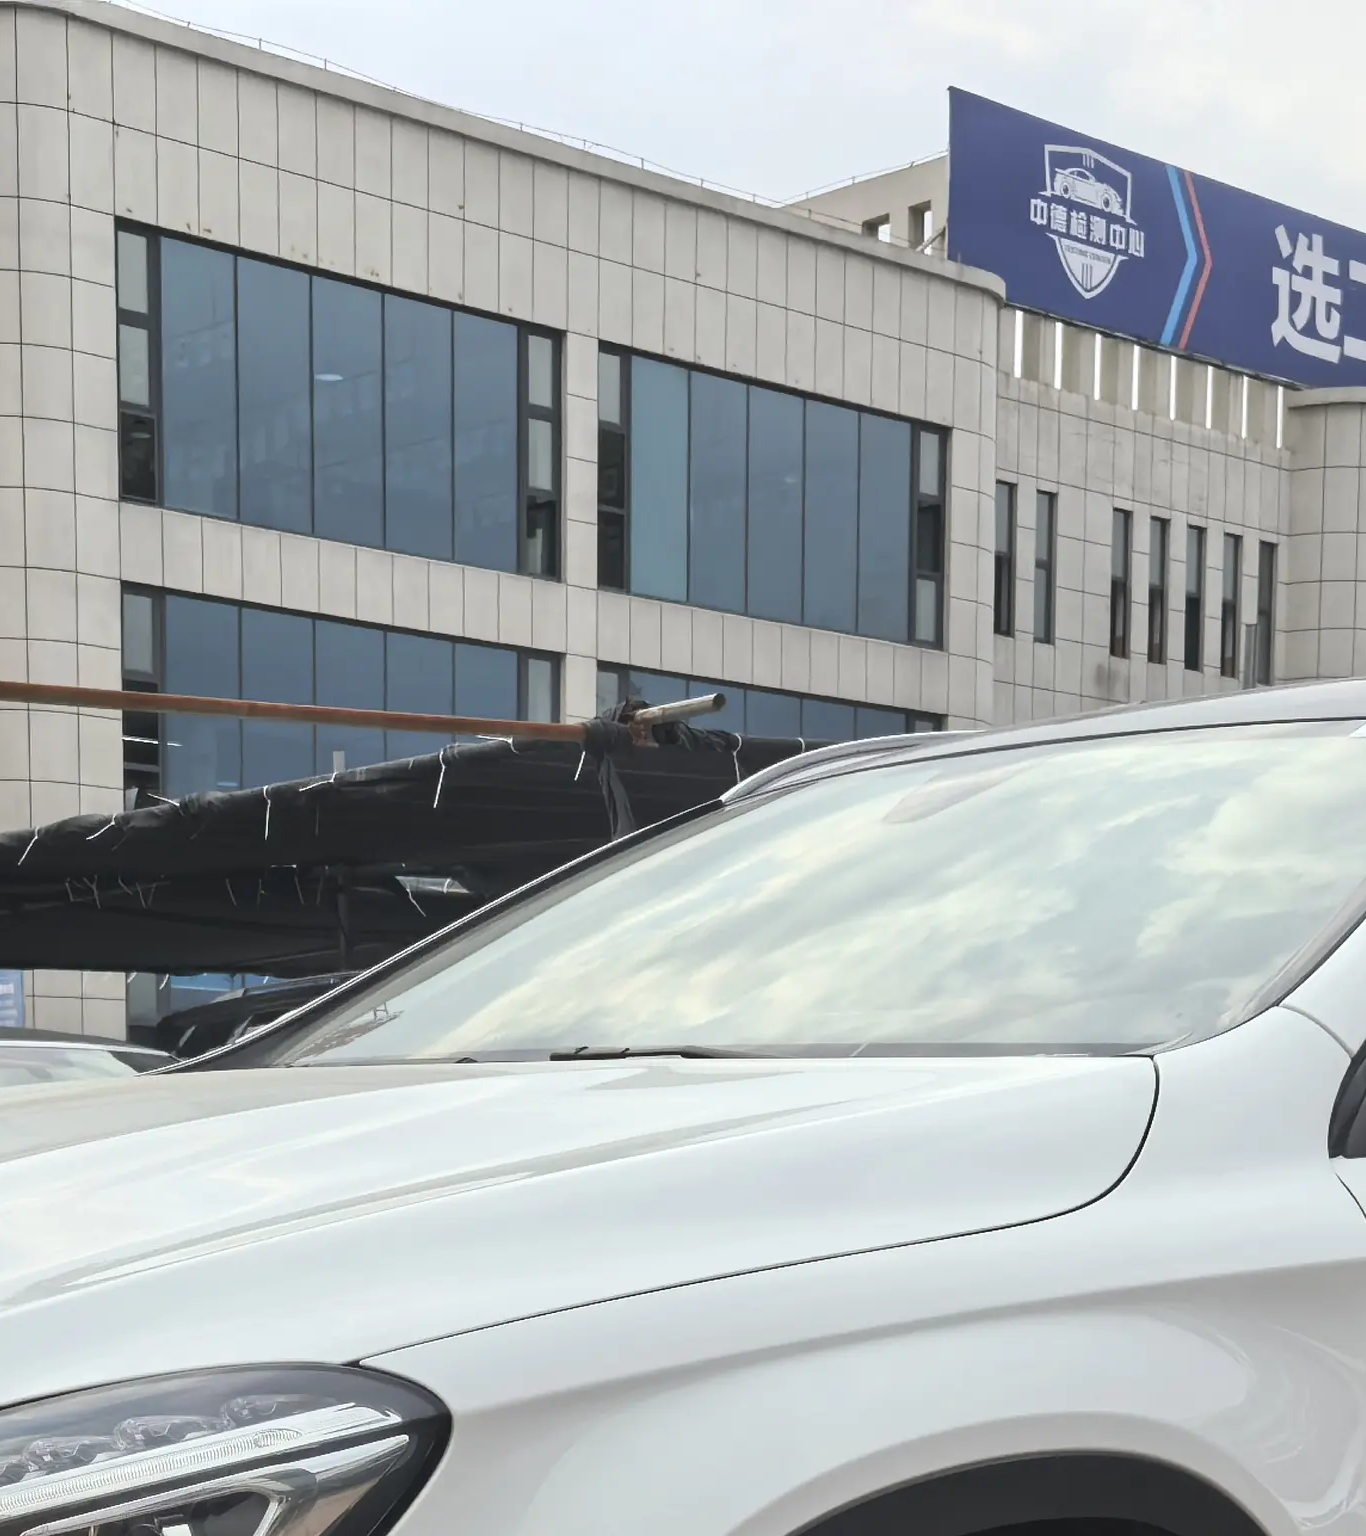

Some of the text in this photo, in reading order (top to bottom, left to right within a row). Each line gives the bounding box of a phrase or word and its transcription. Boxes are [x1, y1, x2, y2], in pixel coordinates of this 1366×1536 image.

[1030, 199, 1145, 258] 中德检测中心
